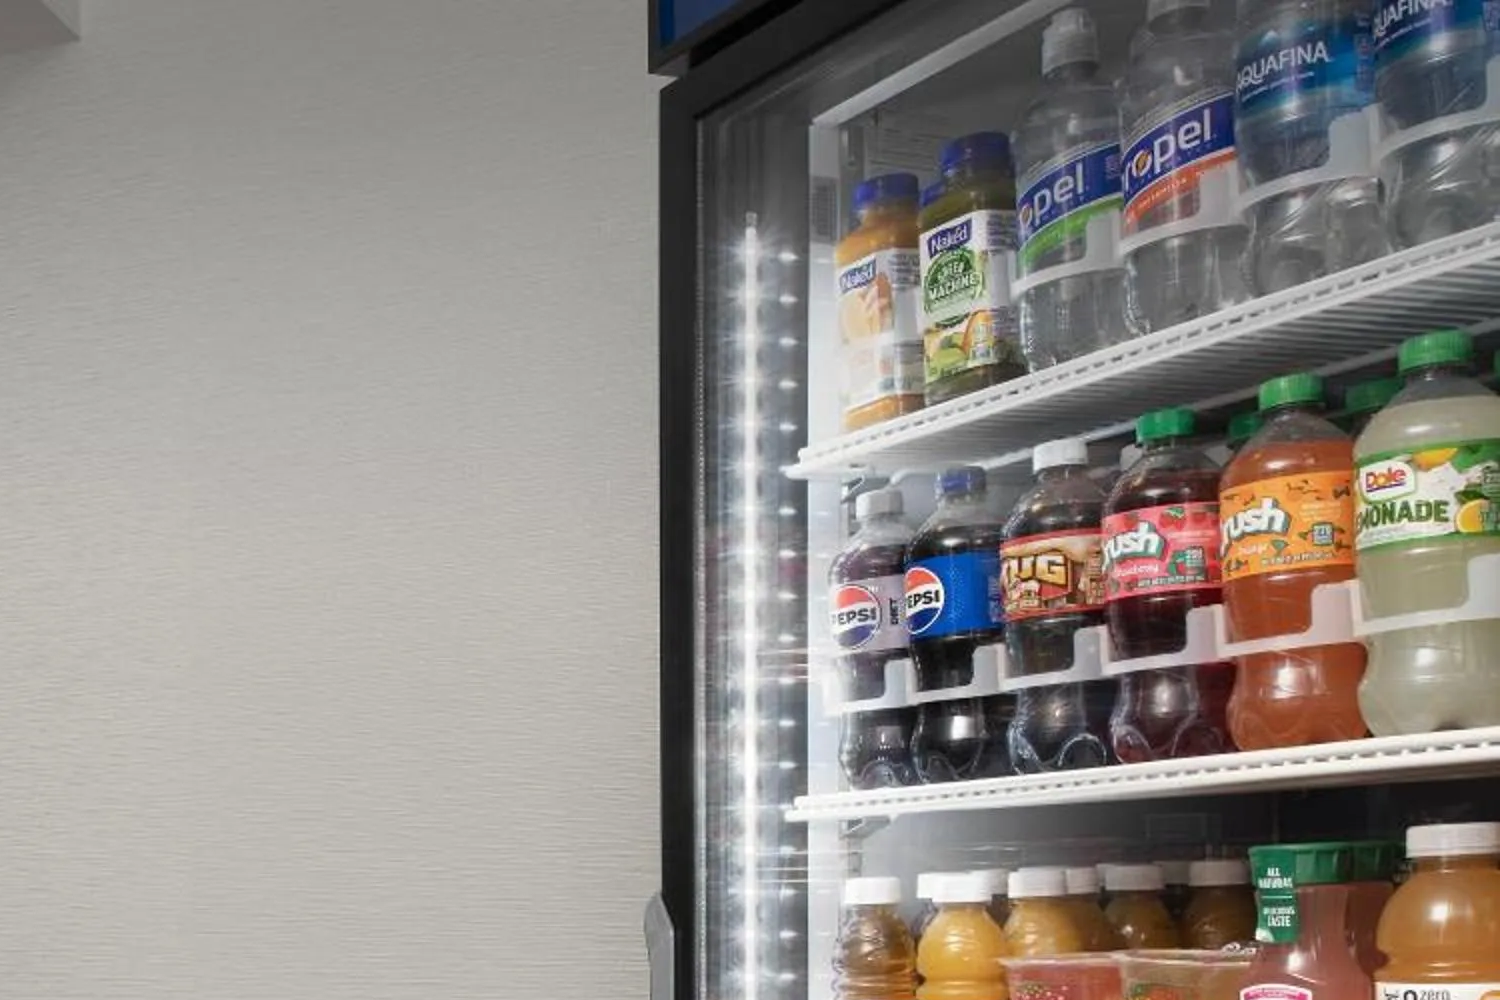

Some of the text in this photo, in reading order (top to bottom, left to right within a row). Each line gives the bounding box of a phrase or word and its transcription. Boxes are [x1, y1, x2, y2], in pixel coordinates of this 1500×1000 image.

[1122, 108, 1213, 192] ropel
[1018, 162, 1085, 228] opel
[1365, 467, 1407, 489] Dole
[906, 589, 940, 609] EPSI
